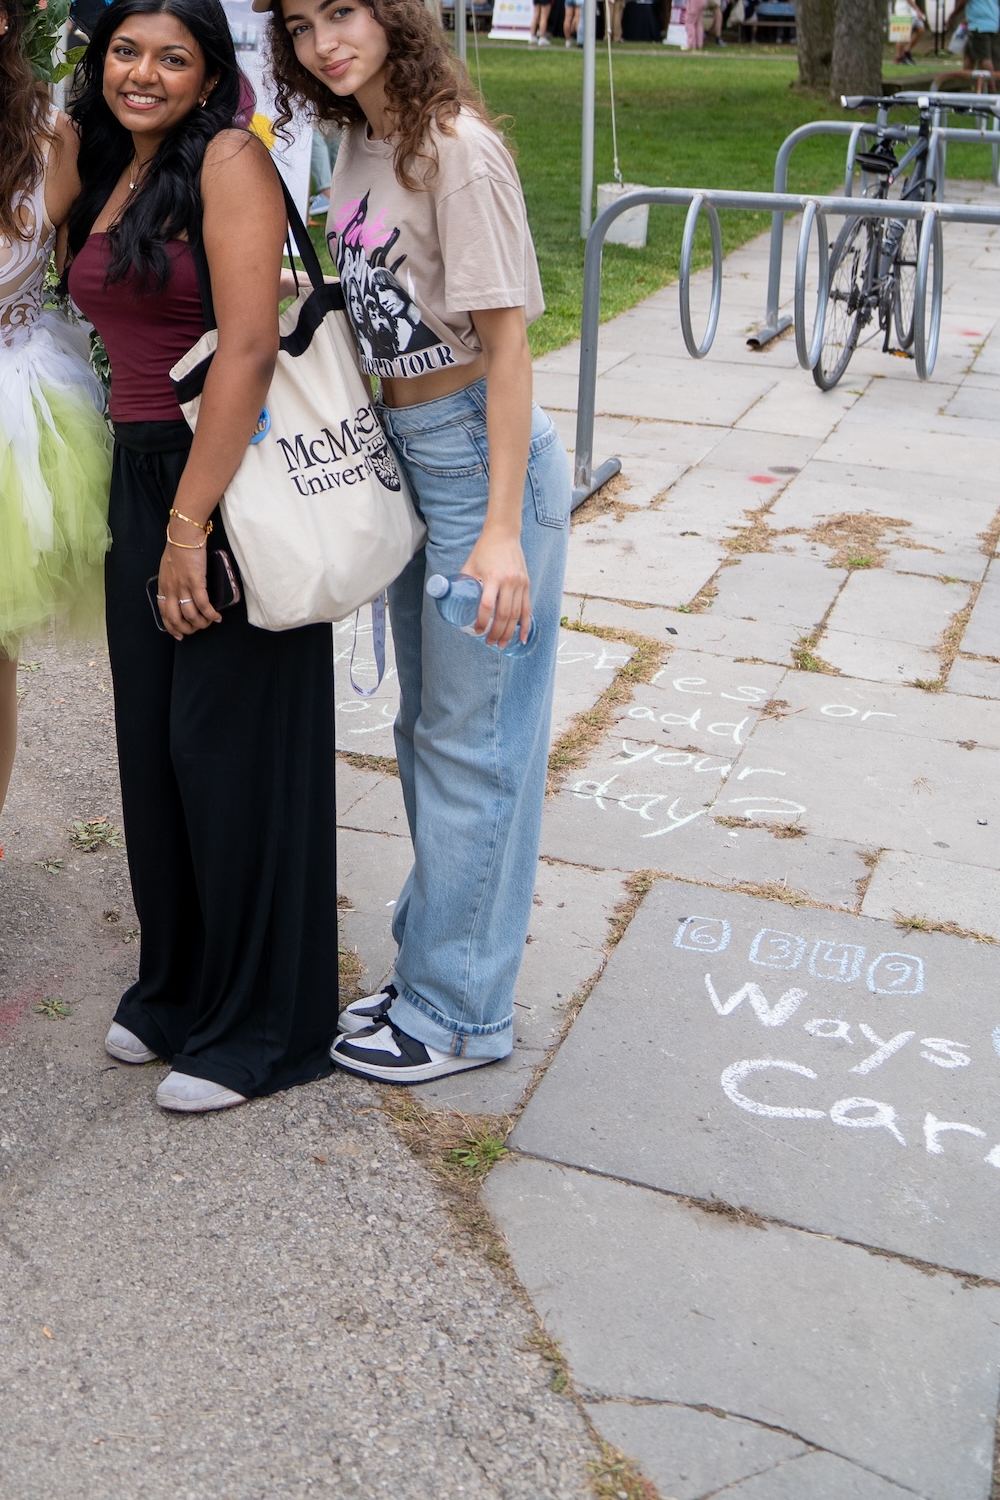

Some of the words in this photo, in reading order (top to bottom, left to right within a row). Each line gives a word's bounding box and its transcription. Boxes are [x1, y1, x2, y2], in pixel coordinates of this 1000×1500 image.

[395, 345, 456, 377] TOUR
[627, 706, 743, 745] add
[820, 705, 897, 722] or
[613, 740, 787, 781] your
[705, 973, 971, 1075] Ways
[721, 1058, 1000, 1167] Car
